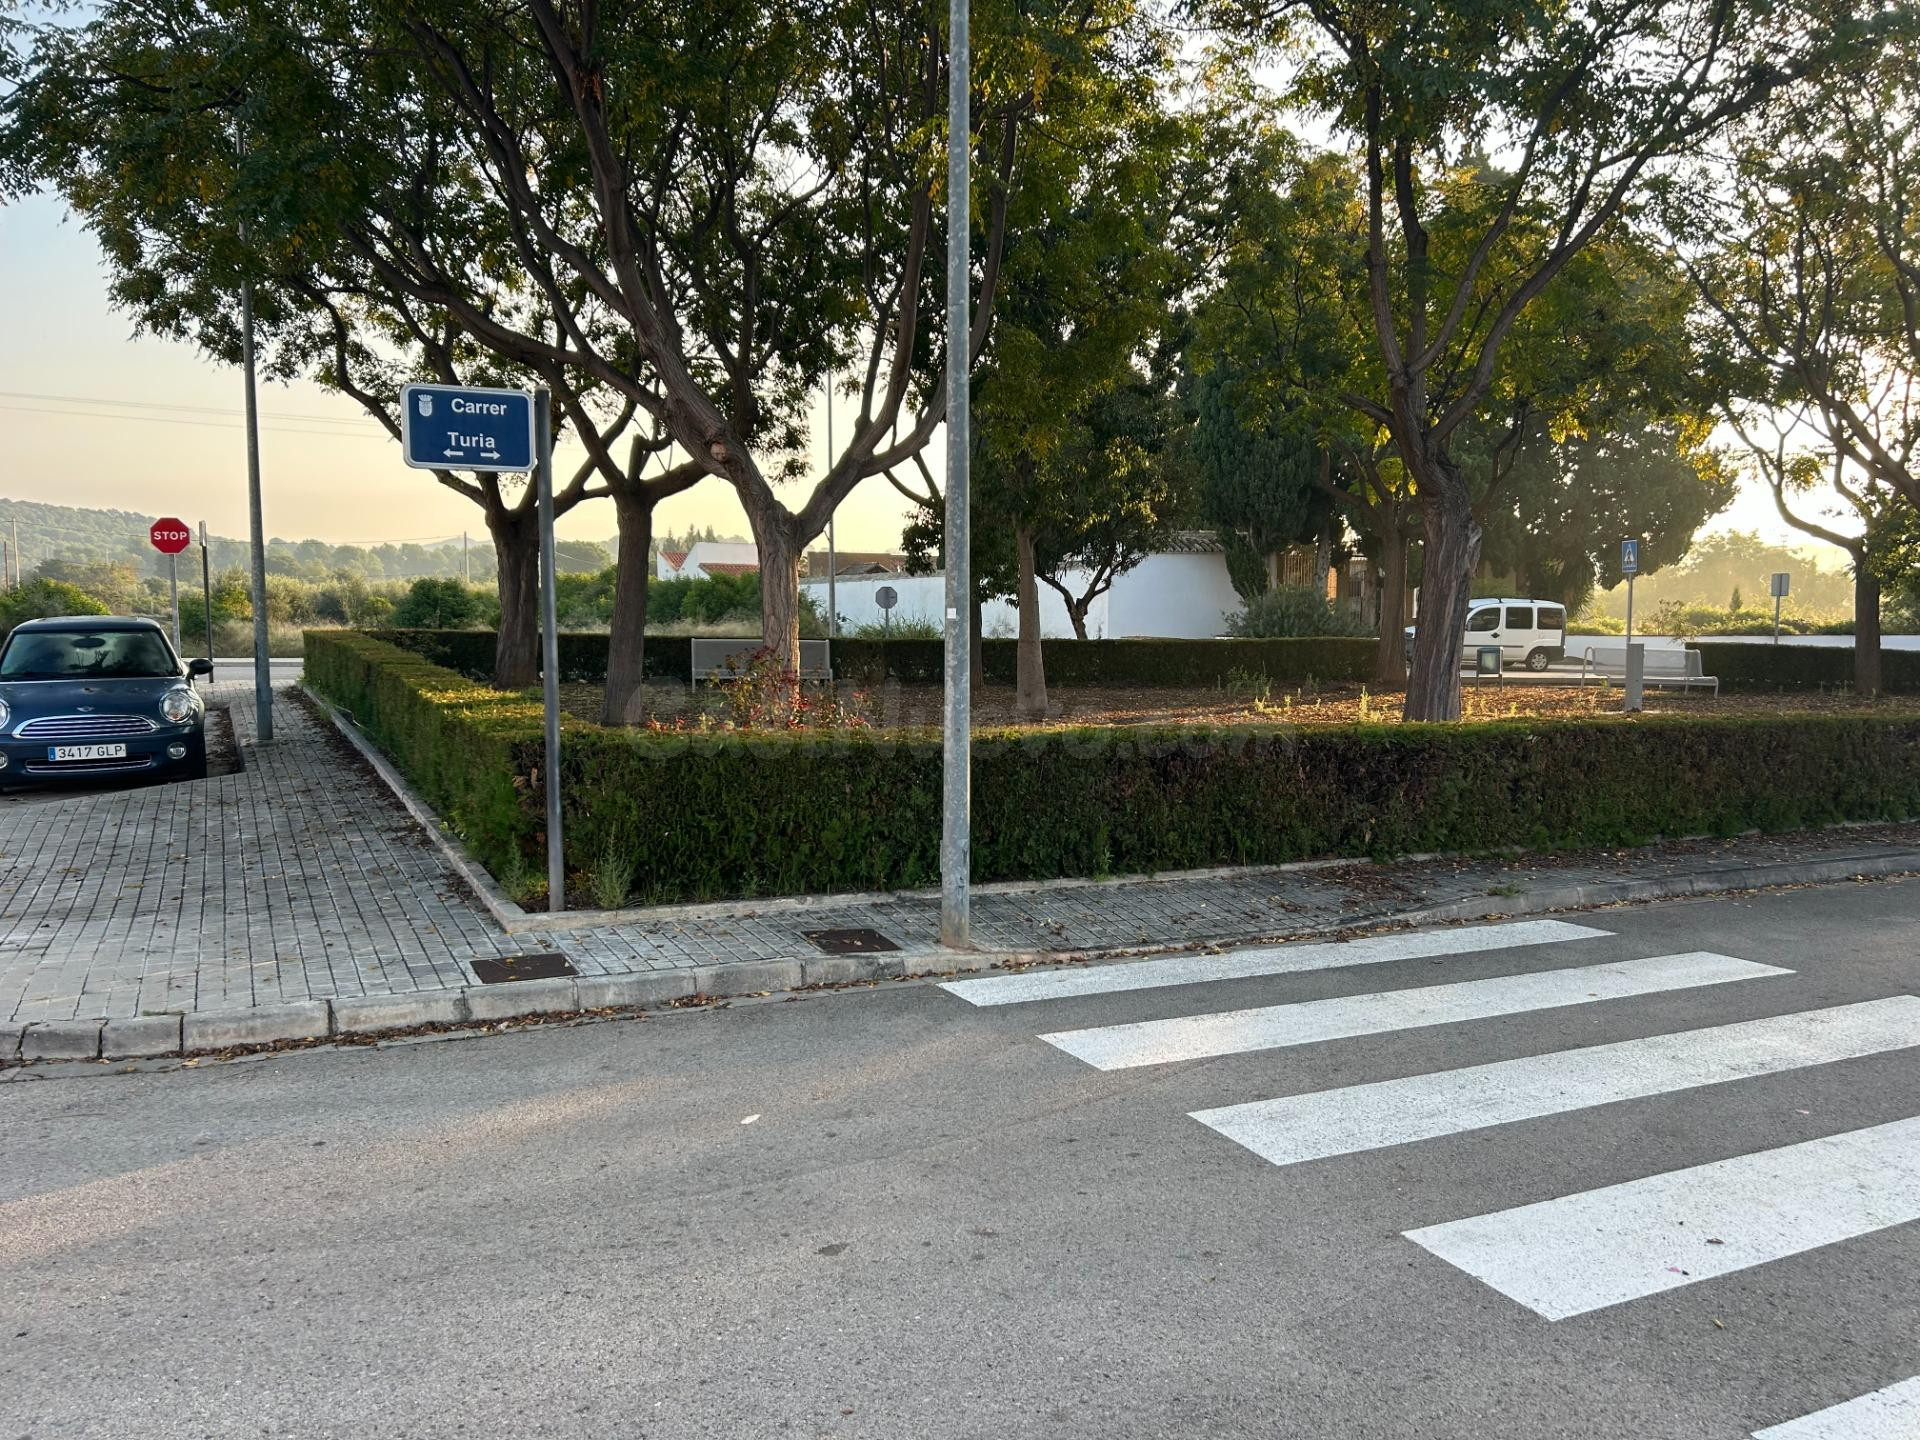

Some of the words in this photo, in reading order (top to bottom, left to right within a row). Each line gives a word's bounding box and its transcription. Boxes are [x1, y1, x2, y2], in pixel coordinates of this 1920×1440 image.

[451, 398, 508, 415] Carrer
[447, 431, 495, 448] Turia
[153, 531, 187, 540] STOP
[58, 747, 92, 758] 3417
[97, 745, 123, 757] GLP
